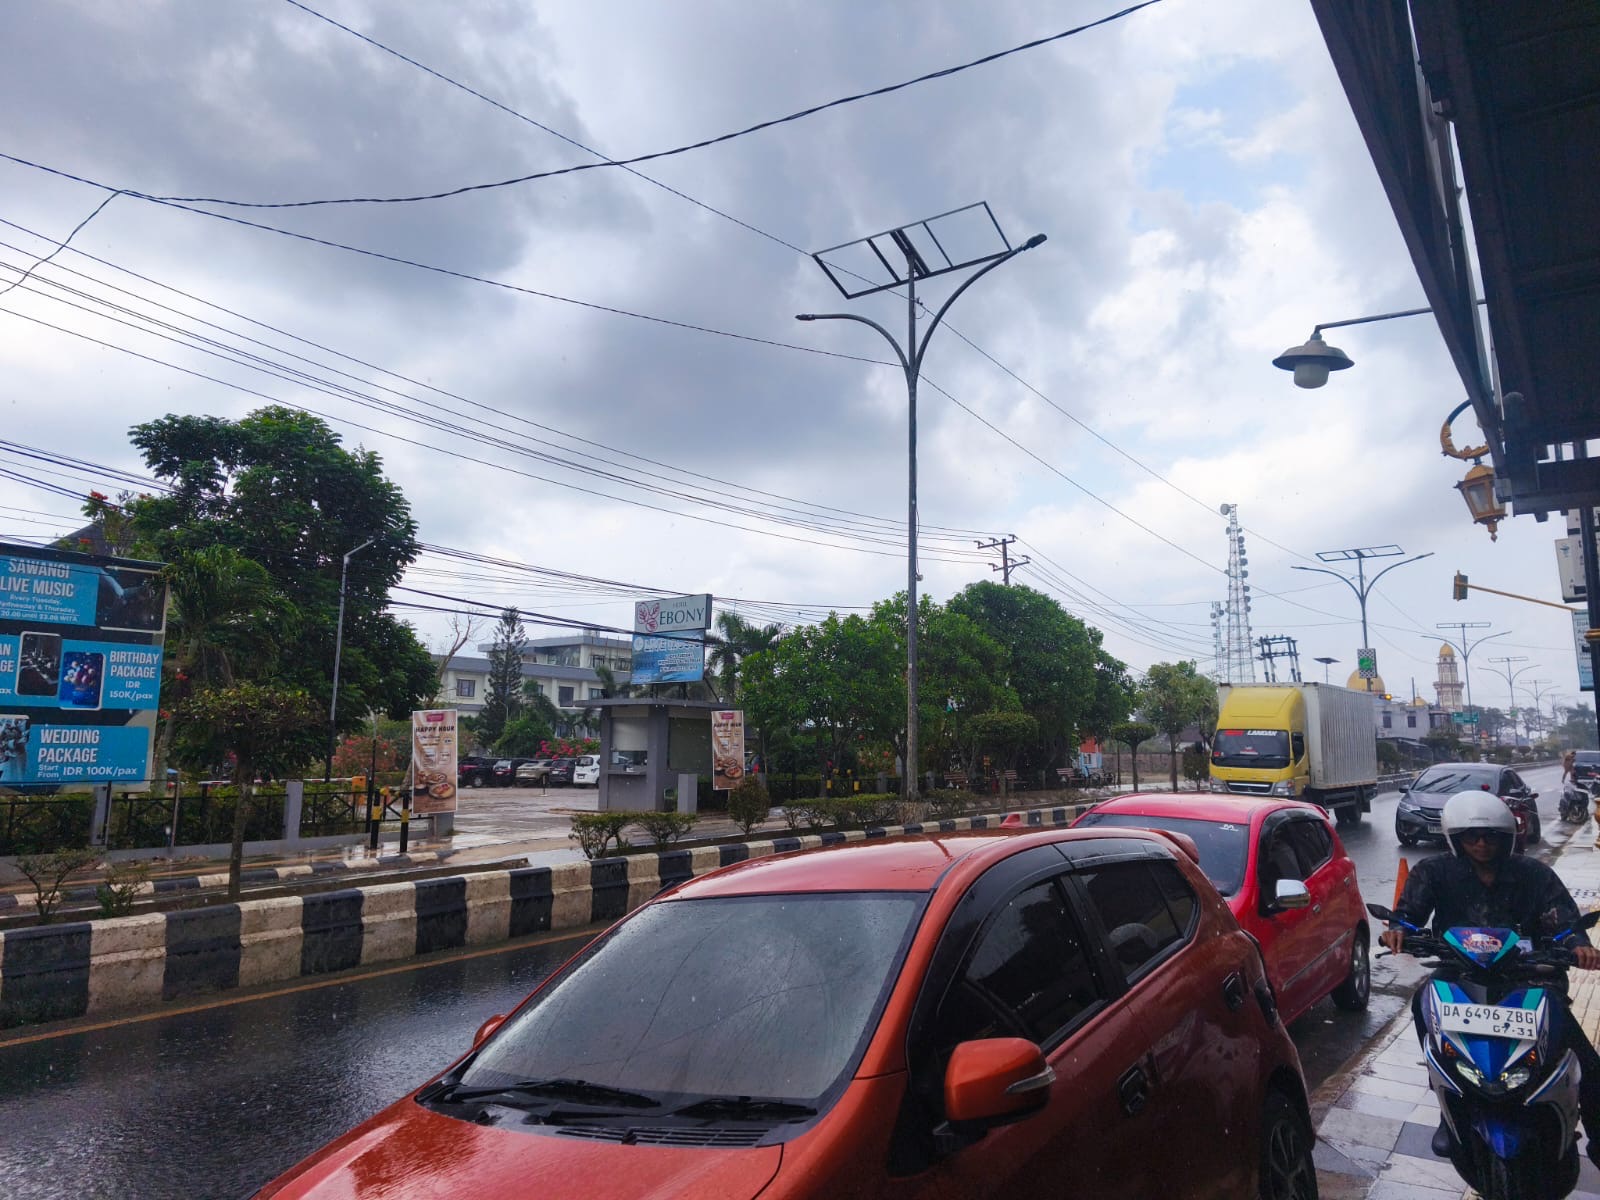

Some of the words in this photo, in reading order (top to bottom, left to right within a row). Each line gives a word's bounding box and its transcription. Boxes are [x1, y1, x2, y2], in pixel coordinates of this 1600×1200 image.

[8, 558, 70, 578] SAWANGI
[0, 576, 29, 593] LIVE
[33, 578, 75, 597] MUSIC
[660, 608, 705, 626] EBONY
[109, 650, 160, 665] BIRTHDAY
[110, 665, 156, 679] PACKAGE
[125, 681, 141, 689] IDR
[40, 729, 100, 744] WEDDING
[38, 747, 98, 763] PACKAGE
[63, 766, 83, 776] IDR
[87, 766, 138, 777] 100K/pax
[1443, 1005, 1460, 1017] DA
[1465, 1006, 1500, 1021] 6496
[1506, 1010, 1534, 1024] ZBG
